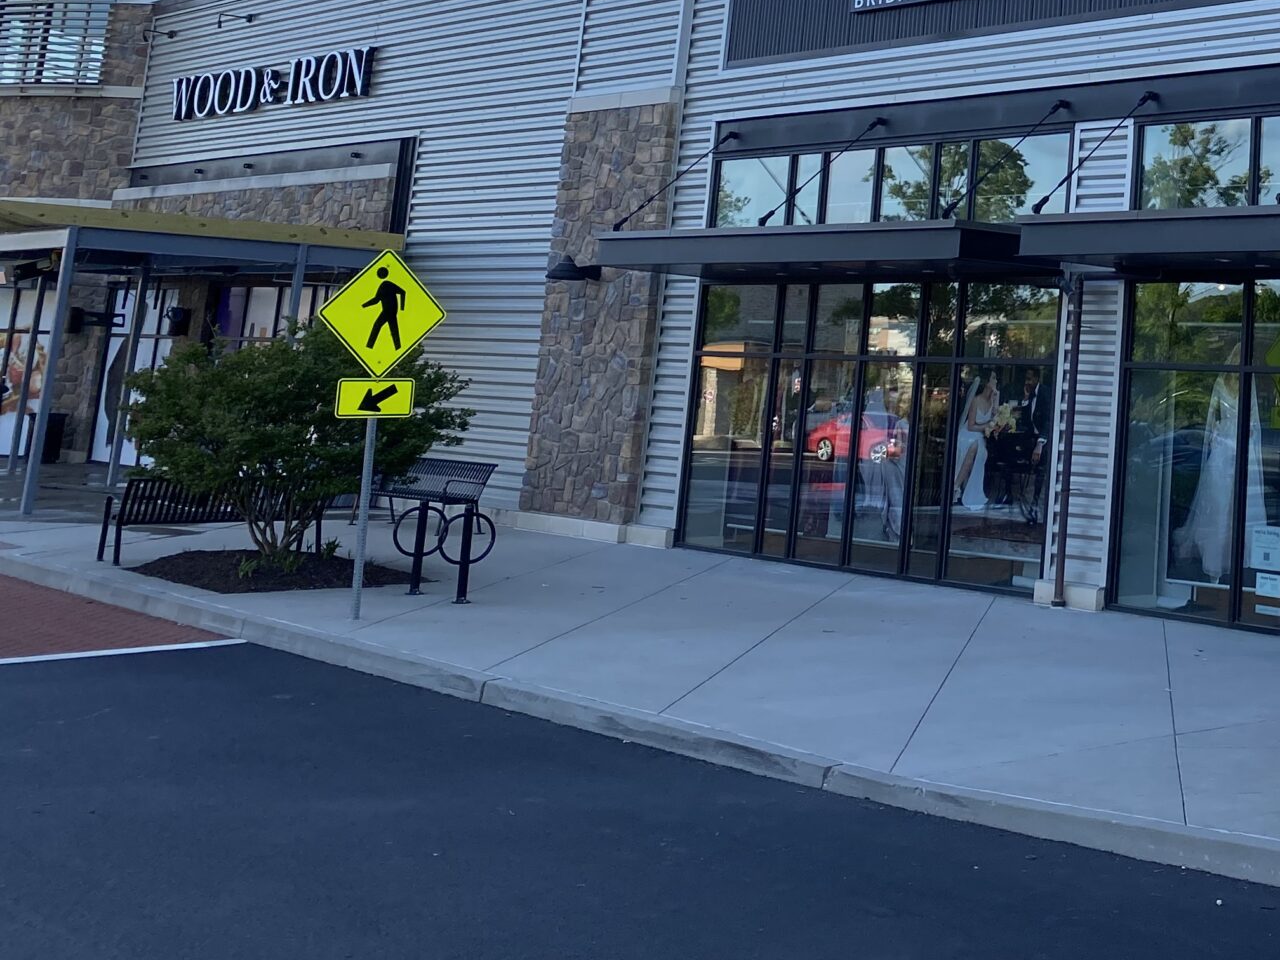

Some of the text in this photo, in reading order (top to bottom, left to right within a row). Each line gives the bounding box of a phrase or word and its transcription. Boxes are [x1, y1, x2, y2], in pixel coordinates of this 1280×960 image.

[172, 46, 374, 121] WOOD & IRON
